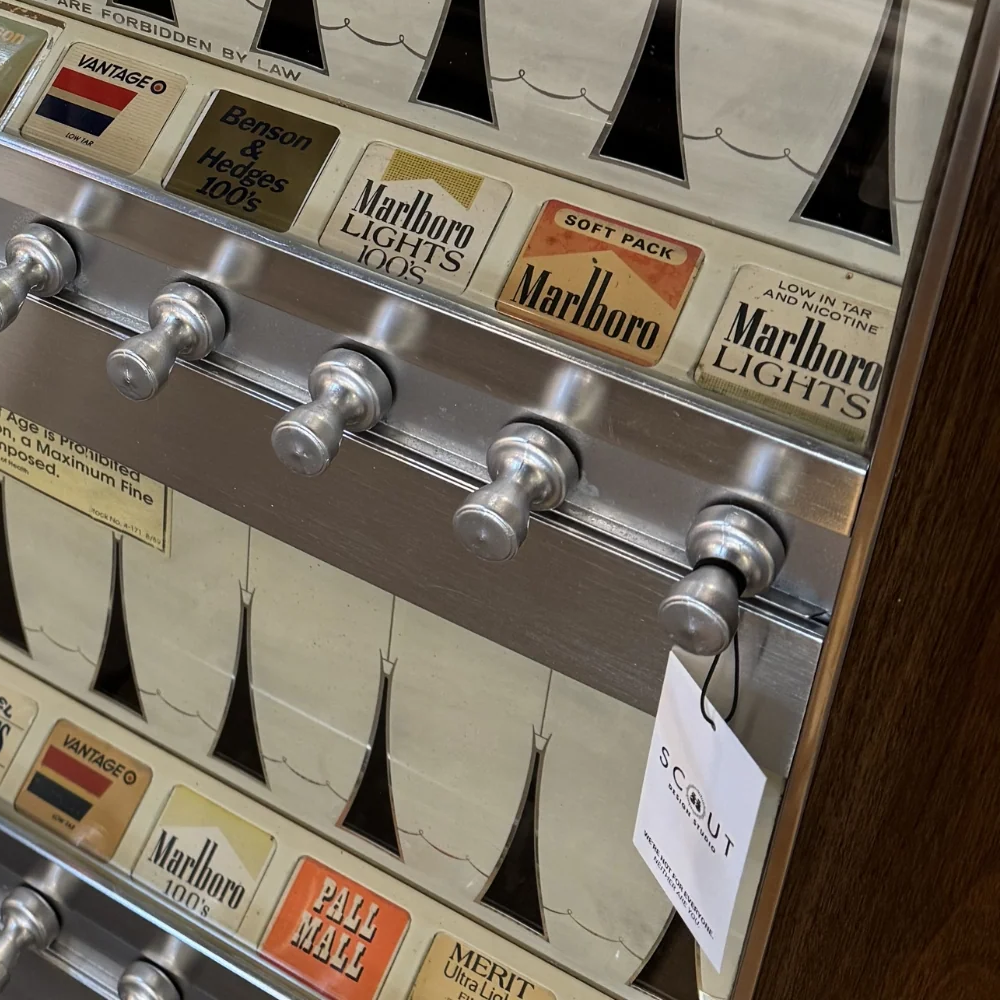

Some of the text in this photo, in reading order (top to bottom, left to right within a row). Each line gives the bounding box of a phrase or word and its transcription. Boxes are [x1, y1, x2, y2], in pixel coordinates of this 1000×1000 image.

[78, 54, 152, 90] VANTAGE
[100, 8, 212, 53] FORBIDDEN
[222, 47, 248, 64] BY
[257, 59, 302, 83] LAW
[65, 132, 95, 147] LOW TAR
[220, 105, 312, 151] Benson
[240, 139, 266, 160] &
[196, 176, 262, 212] 100's
[197, 146, 289, 193] Hedges
[340, 212, 465, 272] LIGHTS
[351, 178, 475, 250] Marlboro
[564, 214, 674, 260] SOFT PACK
[510, 263, 660, 351] Marlboro
[763, 289, 879, 336] AND NICOTINE
[778, 280, 873, 320] LOW IN TAR
[724, 301, 883, 392] Marlboro
[712, 344, 871, 420] LIGHTS
[7, 411, 40, 434] Age
[20, 436, 32, 448] a
[36, 440, 116, 488] Maximum
[120, 480, 154, 506] Fine
[63, 734, 124, 778] VANTAGE
[660, 746, 734, 858] SCOUT
[668, 783, 716, 854] DESIGN STUDIO
[147, 828, 246, 910] Marlboro
[164, 879, 211, 918] 100's
[653, 855, 701, 929] NEITHER ARE YOU.
[660, 854, 672, 874] NOT
[672, 873, 684, 893] FOR
[684, 890, 714, 940] EVERYONE.
[312, 876, 380, 943] PALL
[290, 912, 370, 984] MALL
[443, 960, 479, 993] Ultra
[448, 942, 535, 1000] MERIT
